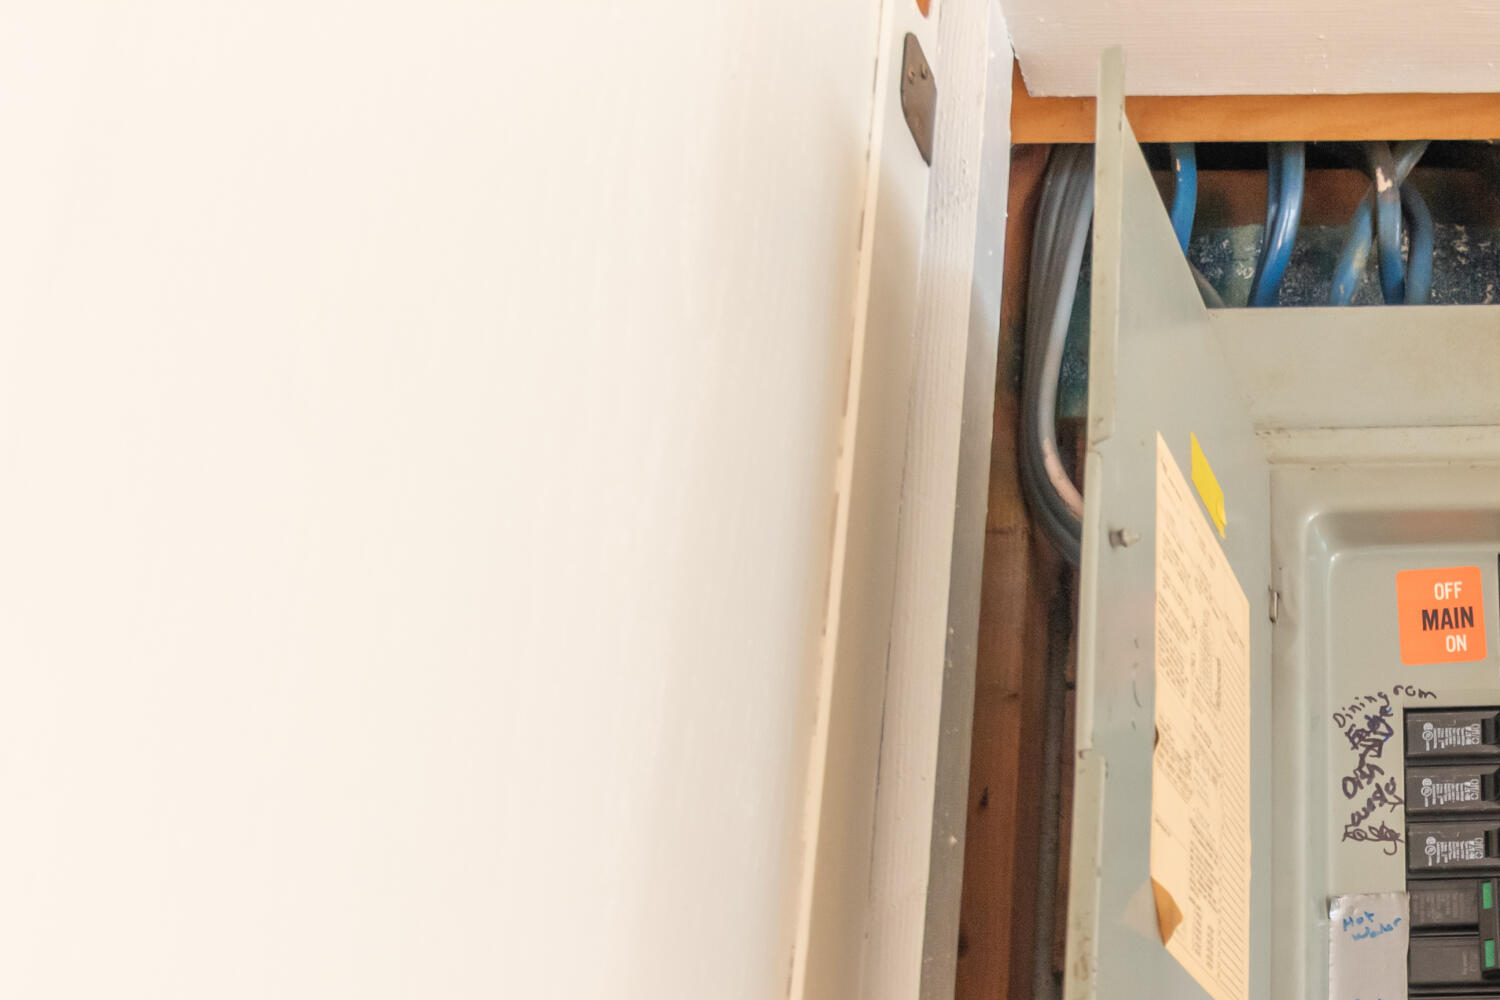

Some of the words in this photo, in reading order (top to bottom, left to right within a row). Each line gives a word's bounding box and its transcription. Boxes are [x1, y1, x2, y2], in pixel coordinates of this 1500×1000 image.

[1434, 581, 1463, 600] OFF
[1422, 606, 1475, 631] MAIN
[1445, 634, 1468, 653] ON
